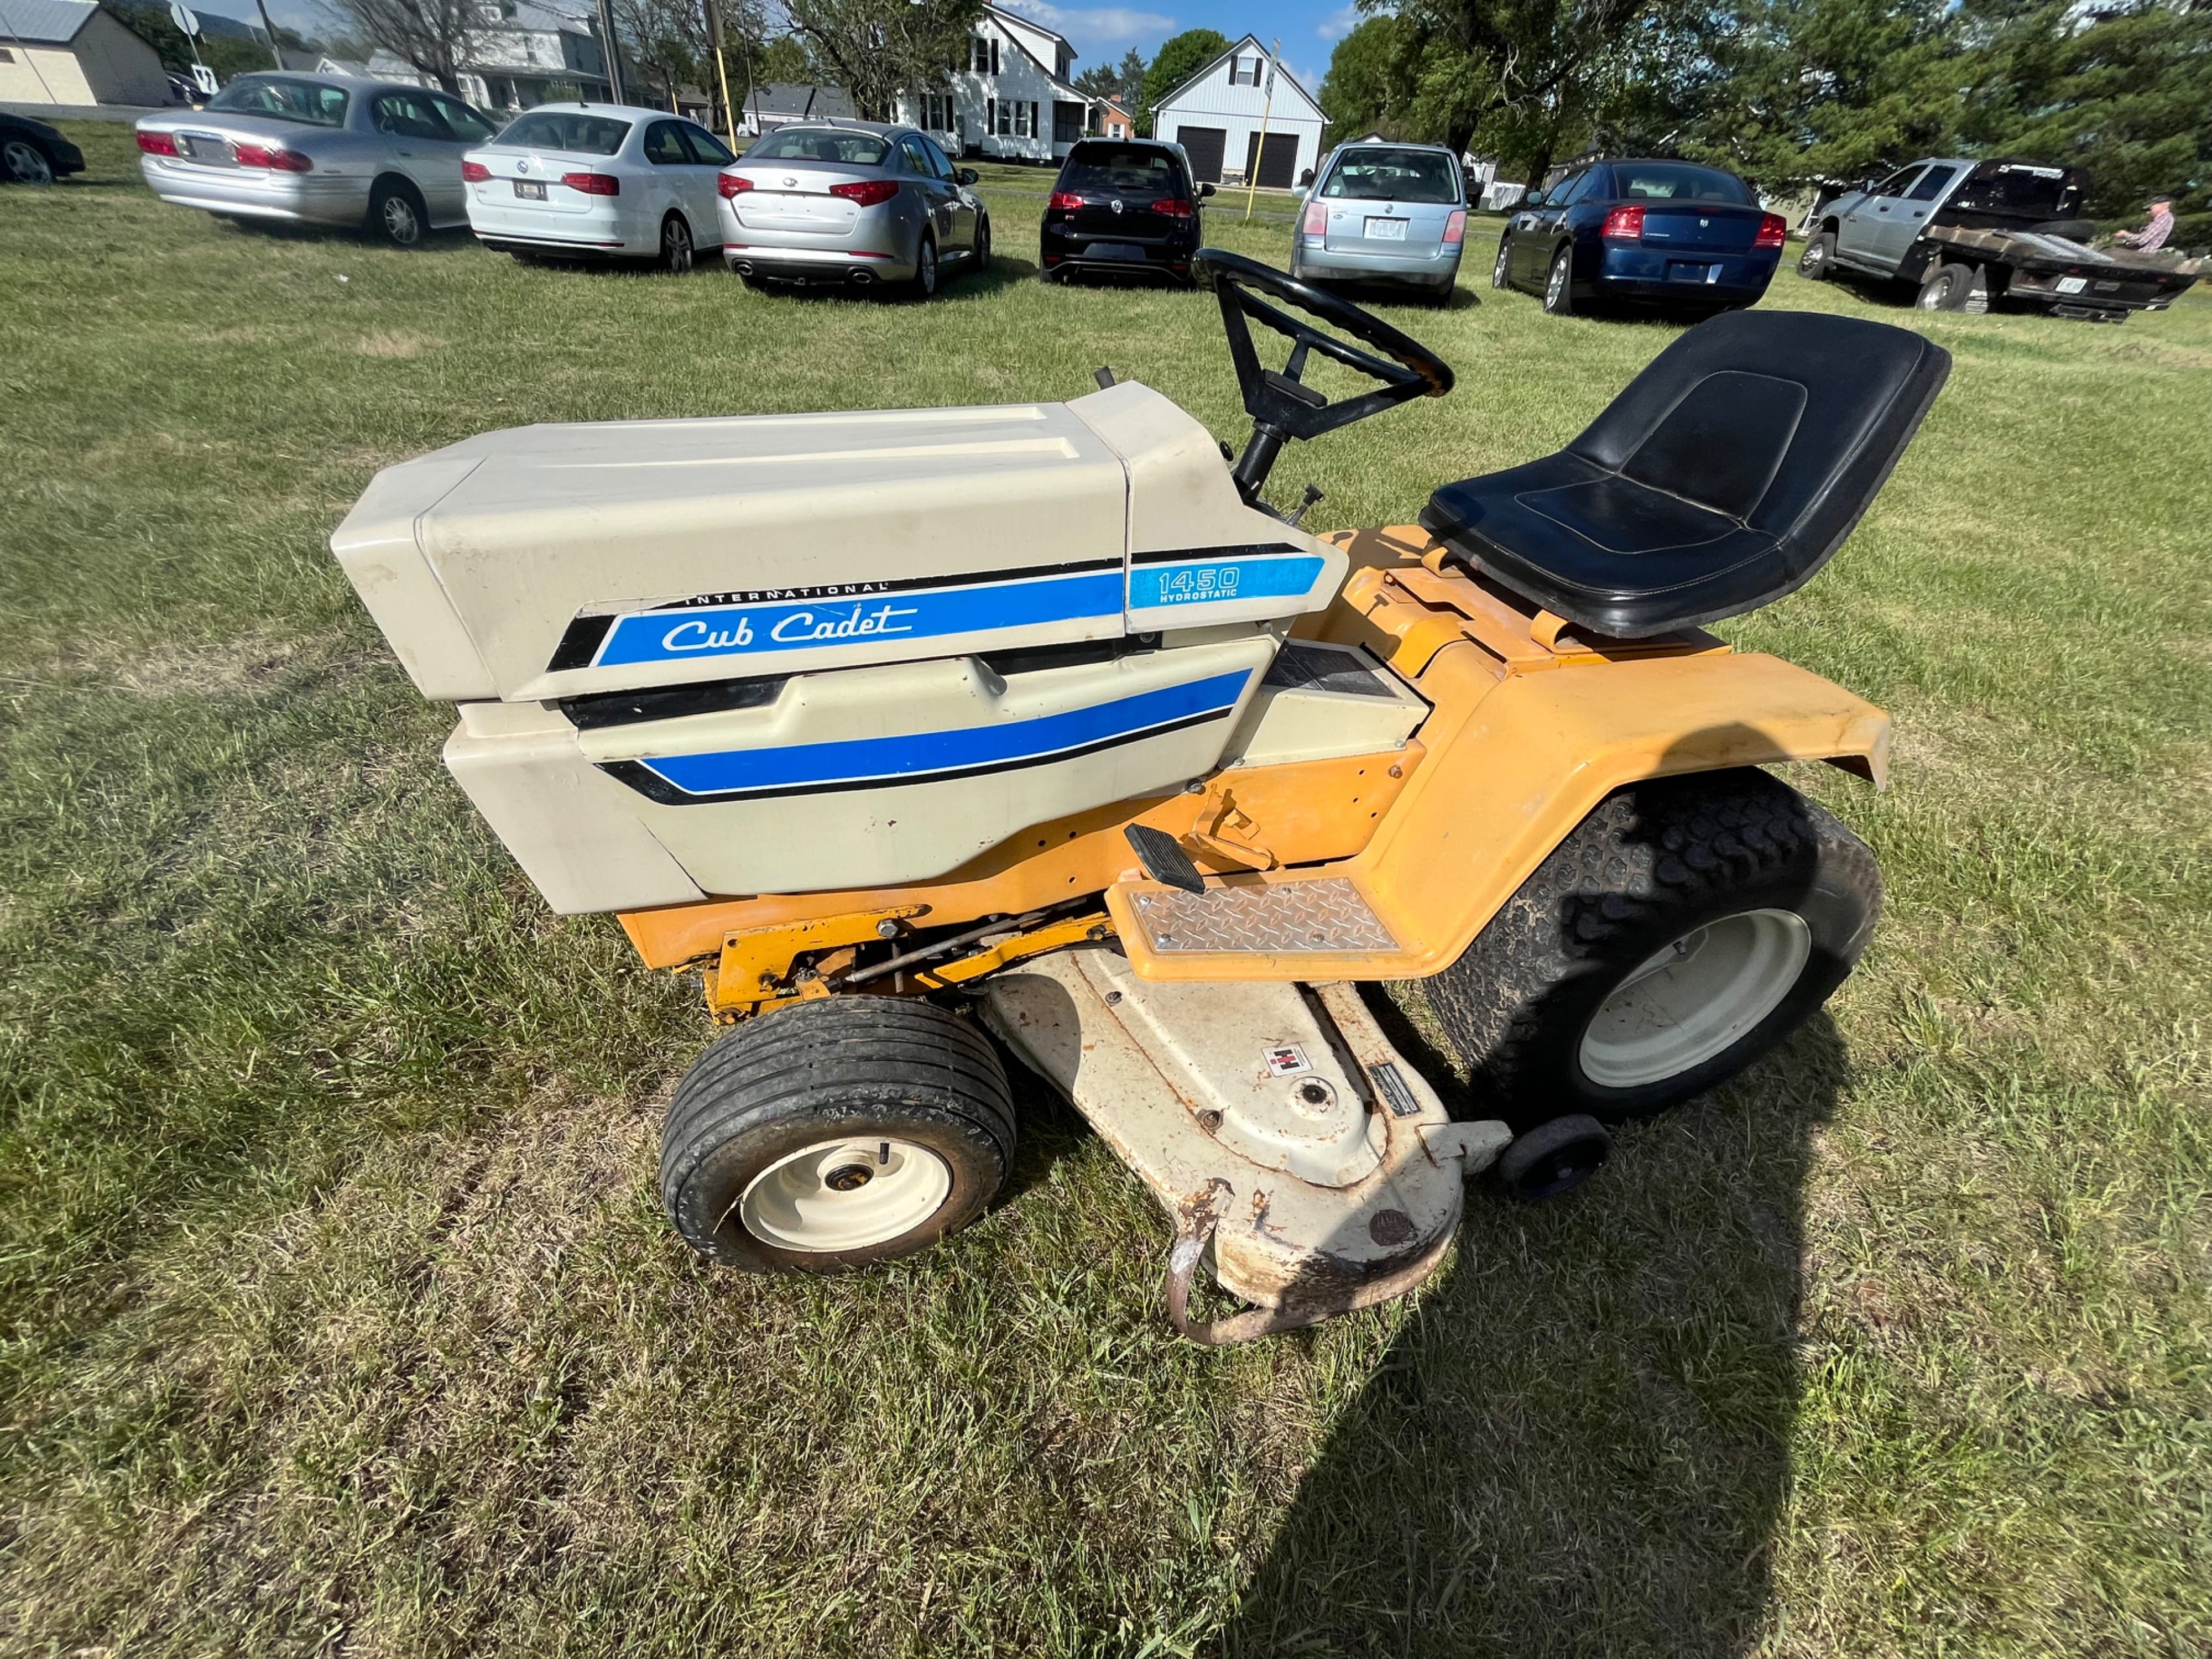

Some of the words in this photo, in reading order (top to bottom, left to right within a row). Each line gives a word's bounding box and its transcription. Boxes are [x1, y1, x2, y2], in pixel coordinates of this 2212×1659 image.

[685, 581, 889, 606] INTERNATIONAL
[1159, 567, 1240, 594] 1450
[1160, 588, 1238, 603] HYDROSTATIC
[661, 617, 754, 651] Cub
[770, 602, 918, 643] Cadet
